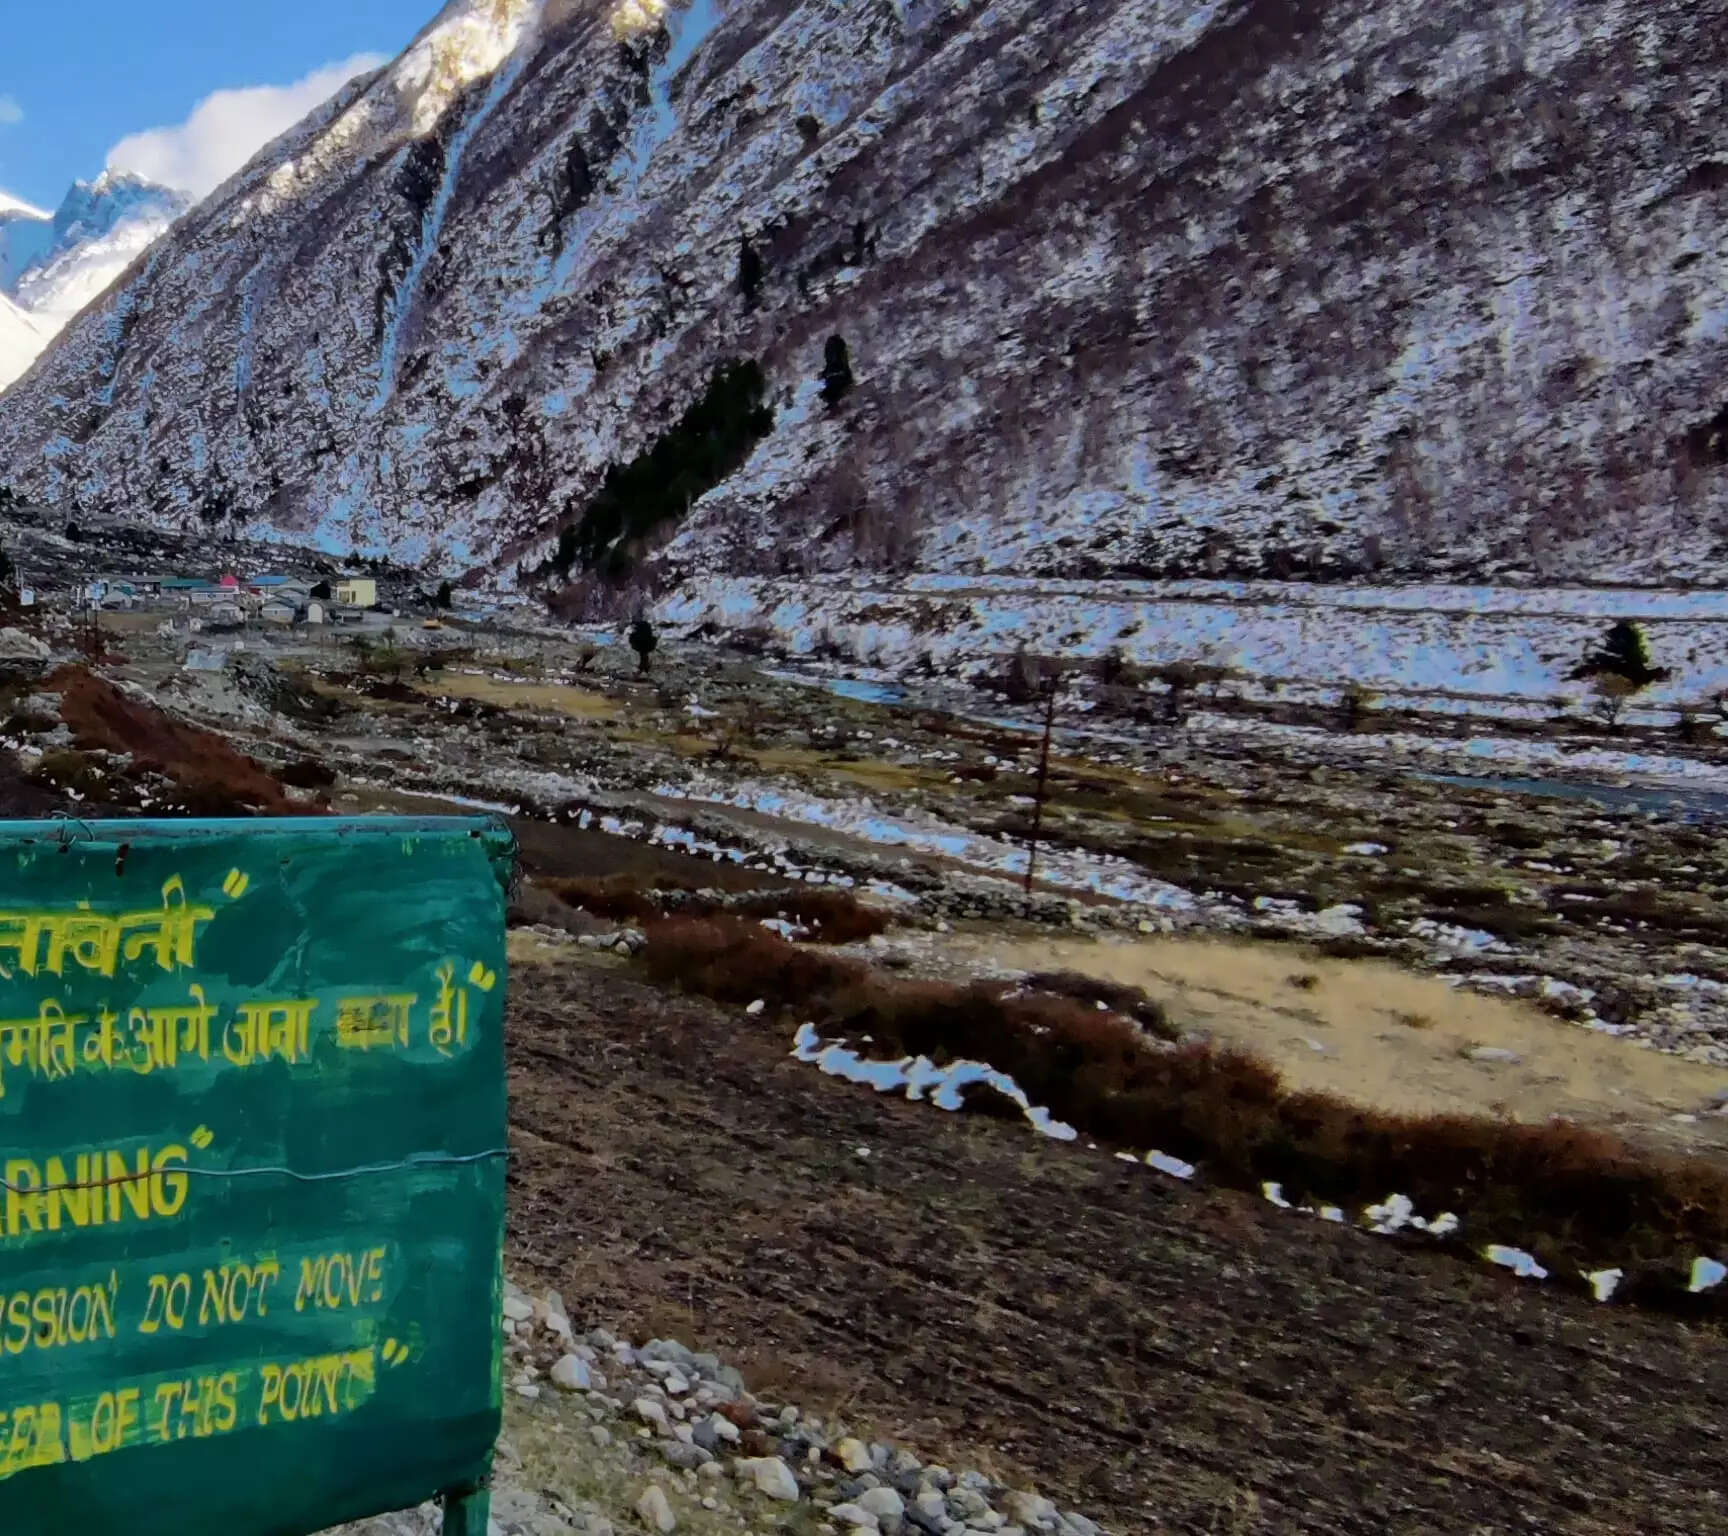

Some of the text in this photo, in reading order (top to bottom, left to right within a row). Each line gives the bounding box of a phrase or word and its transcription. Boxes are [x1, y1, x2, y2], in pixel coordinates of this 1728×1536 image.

[126, 983, 218, 1075] आगे
[138, 1273, 191, 1333] DO
[199, 1260, 280, 1324] NOT
[294, 1244, 387, 1312] MOVE
[92, 1388, 140, 1455] OF
[155, 1371, 237, 1441] THIS
